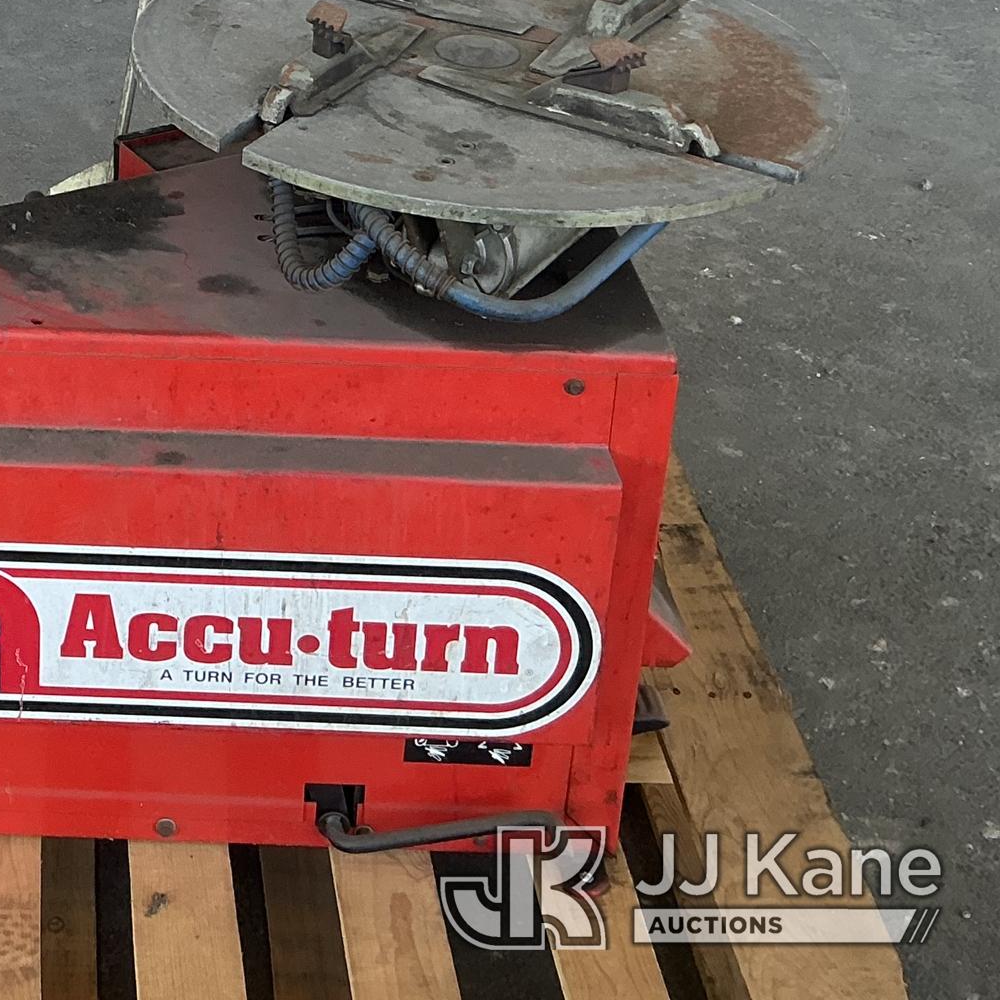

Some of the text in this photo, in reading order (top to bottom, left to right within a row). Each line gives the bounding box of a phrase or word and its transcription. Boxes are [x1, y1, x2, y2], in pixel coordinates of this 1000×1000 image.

[160, 669, 415, 690] A TURN FOR THE BETTER
